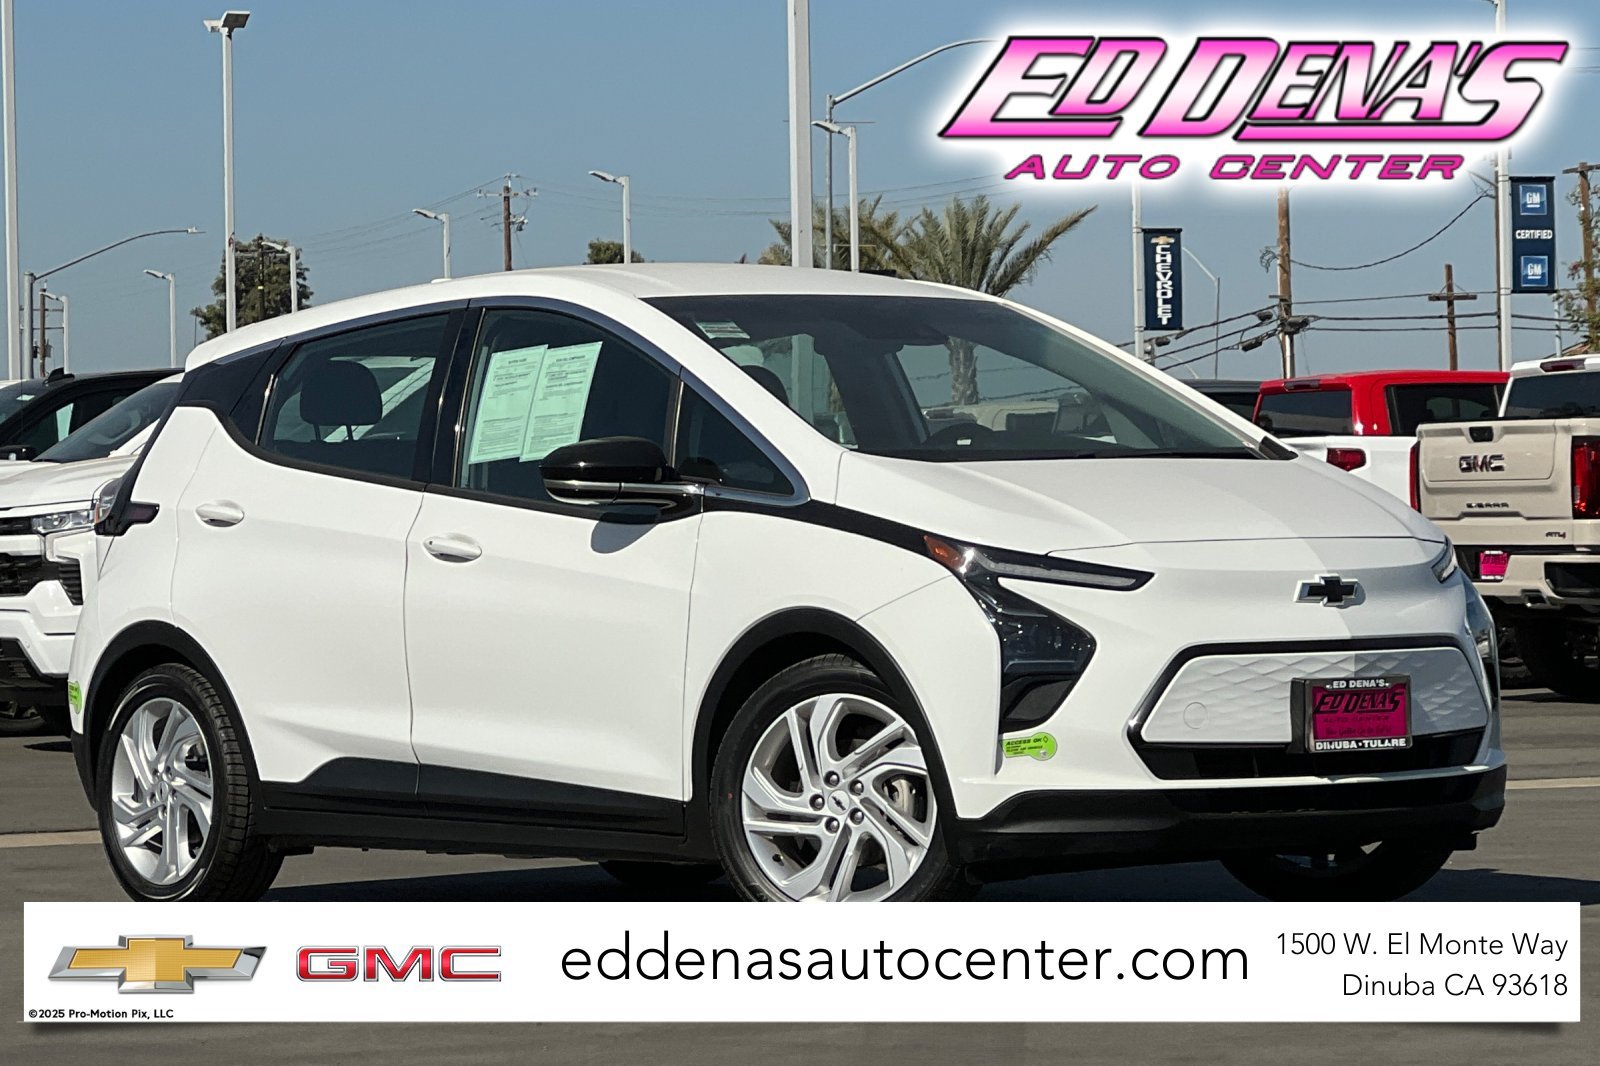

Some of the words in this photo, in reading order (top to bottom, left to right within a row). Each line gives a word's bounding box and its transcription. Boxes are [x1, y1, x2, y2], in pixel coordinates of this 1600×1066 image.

[1526, 192, 1540, 204] GM
[1515, 229, 1553, 239] CERTIFIED
[1527, 263, 1542, 276] GM
[1155, 244, 1173, 325] CHEVROLET
[1459, 454, 1505, 473] GMC
[1333, 680, 1346, 688] ED
[1349, 679, 1385, 688] DENA'S
